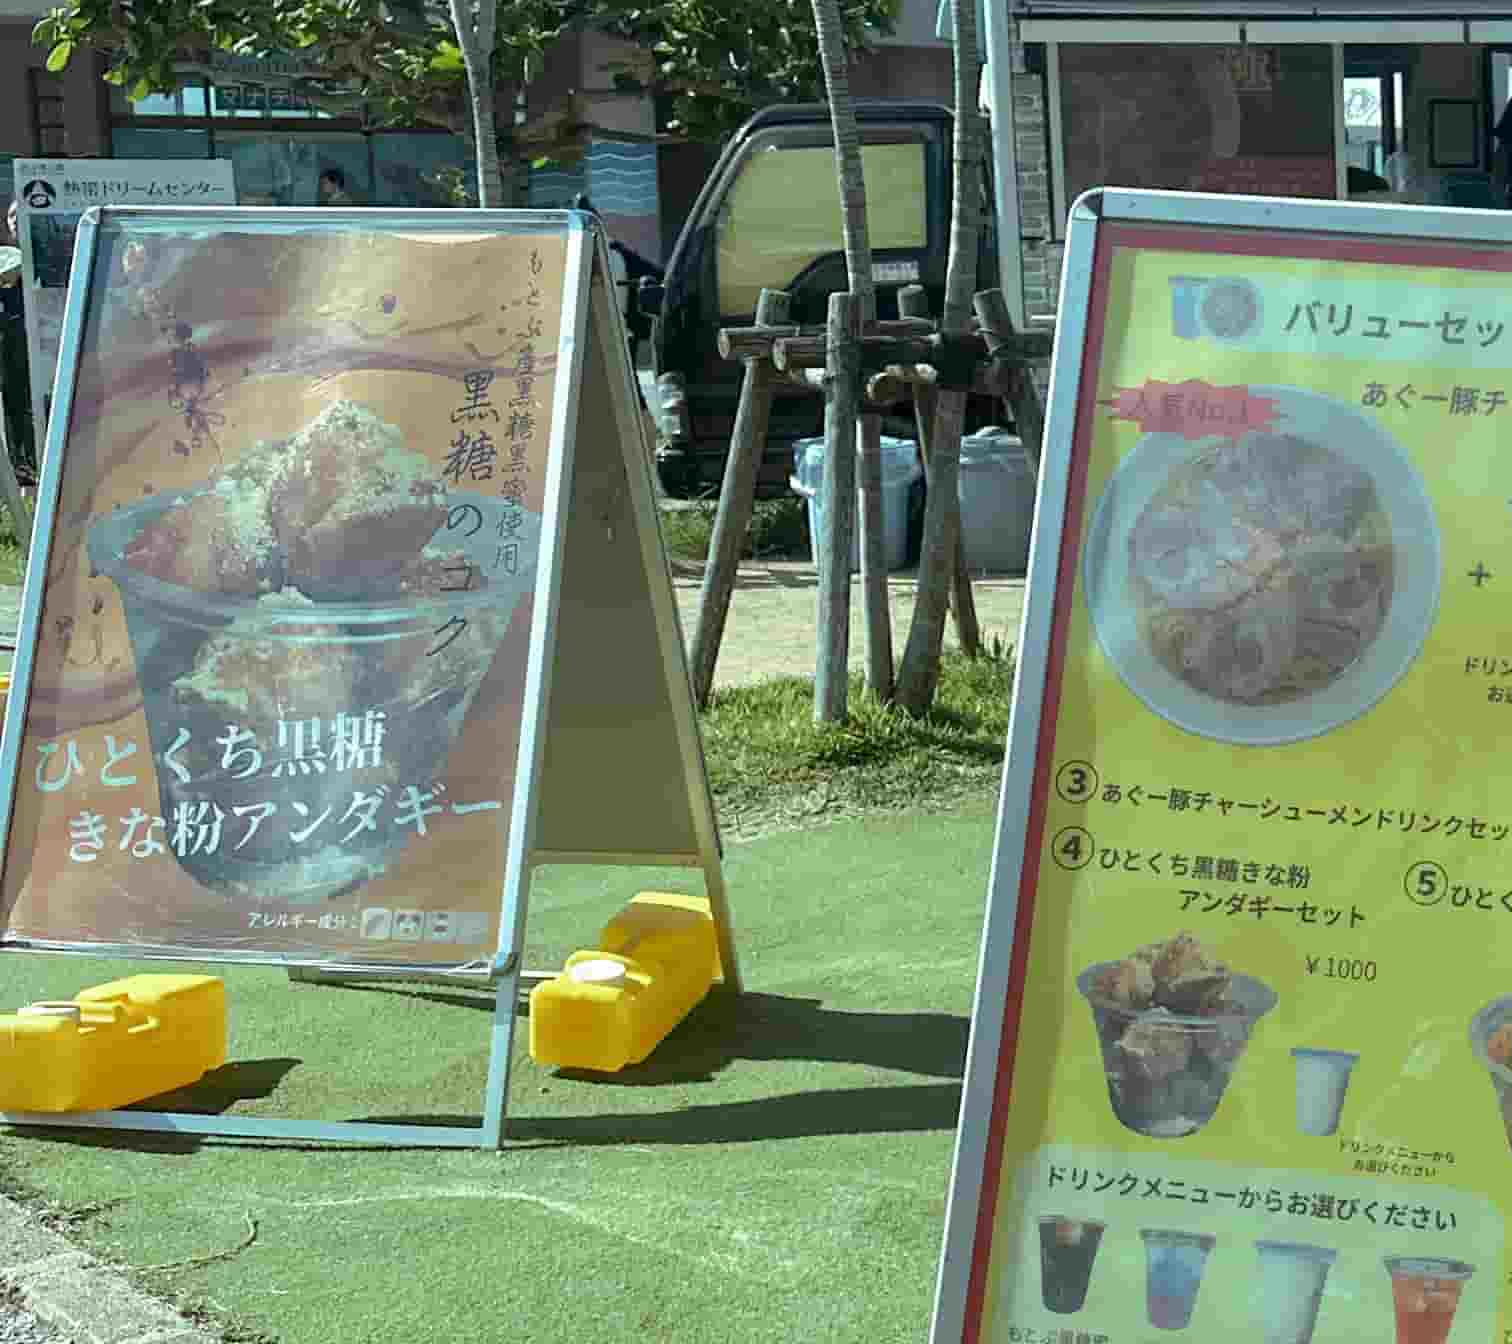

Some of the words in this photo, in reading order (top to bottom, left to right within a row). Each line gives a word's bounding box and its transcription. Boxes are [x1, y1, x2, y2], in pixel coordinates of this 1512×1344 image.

[427, 367, 499, 658] 黒糖のコク
[34, 710, 388, 793] ひとくち黒糖
[67, 782, 501, 863] きな粉アンダギー
[1099, 848, 1312, 889] ひとくち黒糖きな粉
[1178, 888, 1366, 929] アンダギーセット
[1305, 954, 1377, 982] ¥1000
[1046, 1164, 1458, 1233] ドリンクメニューからお選びください
